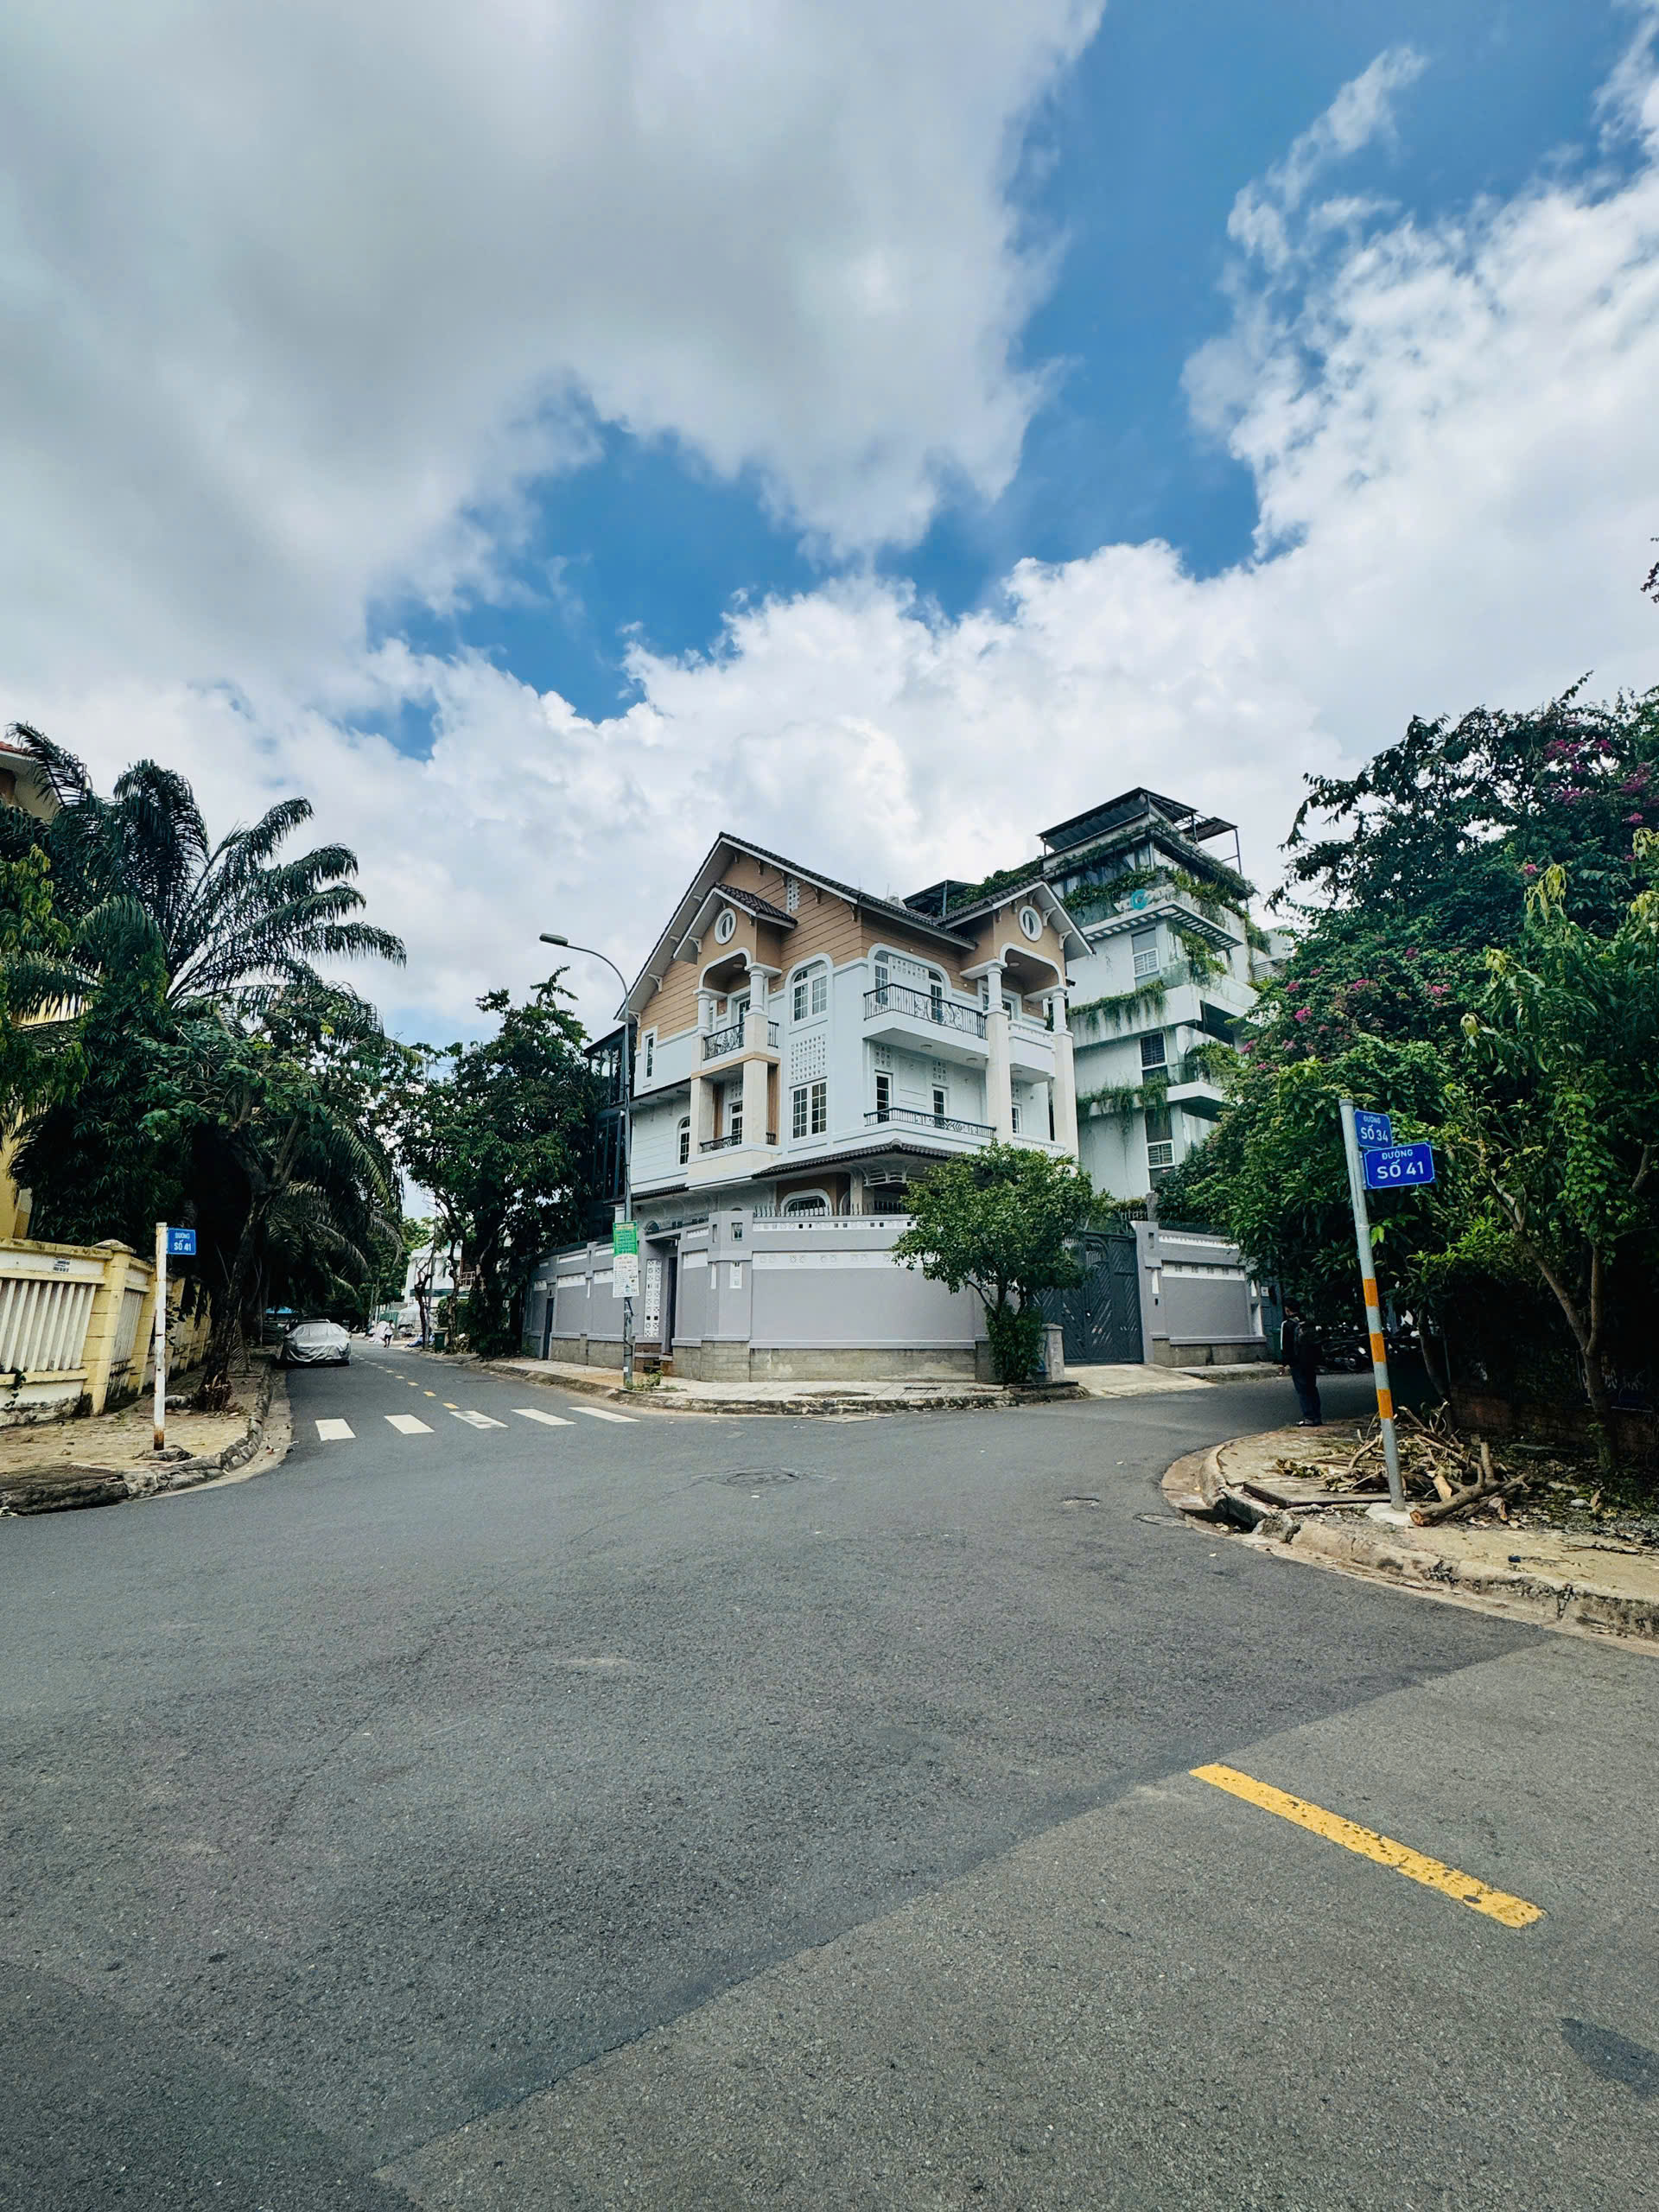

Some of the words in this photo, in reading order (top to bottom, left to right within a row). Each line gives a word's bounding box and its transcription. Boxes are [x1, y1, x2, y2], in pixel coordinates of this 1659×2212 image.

[1360, 1124, 1375, 1141] SỐ
[1376, 1129, 1389, 1142] 34
[1382, 1148, 1414, 1160] ĐƯỜNG
[1376, 1159, 1402, 1179] SỐ
[1406, 1160, 1424, 1176] 41
[174, 1239, 183, 1251] SỐ
[184, 1243, 192, 1252] 41
